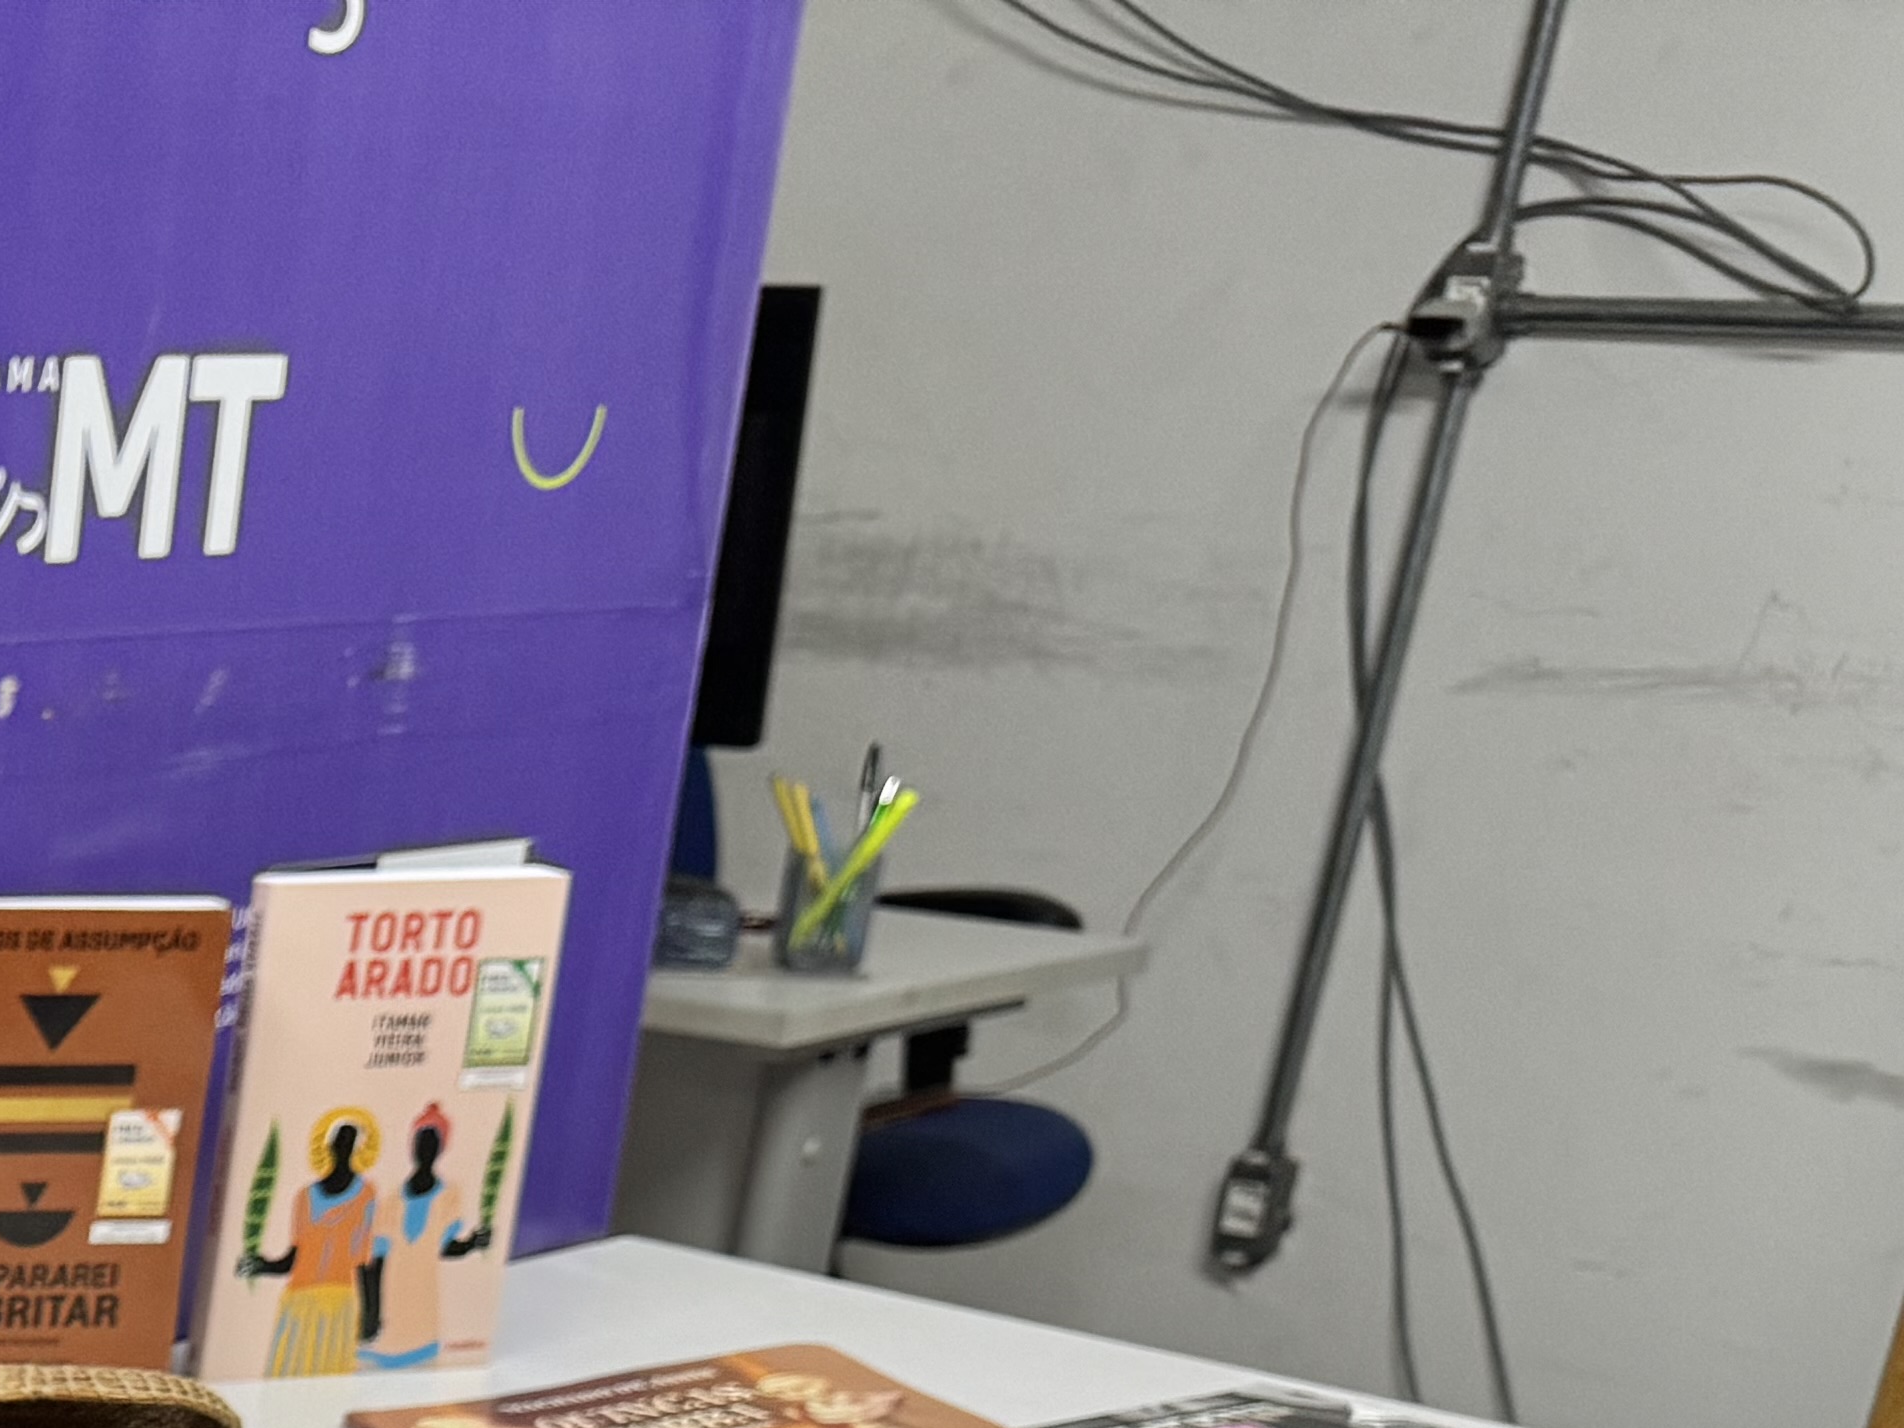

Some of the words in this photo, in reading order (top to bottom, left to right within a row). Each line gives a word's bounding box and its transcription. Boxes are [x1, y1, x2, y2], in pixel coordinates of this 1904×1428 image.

[44, 354, 289, 564] MT
[27, 929, 54, 951] DE
[60, 926, 200, 957] ASSUMPÇÃO
[345, 908, 482, 953] TORTO
[334, 956, 474, 1001] ARADO
